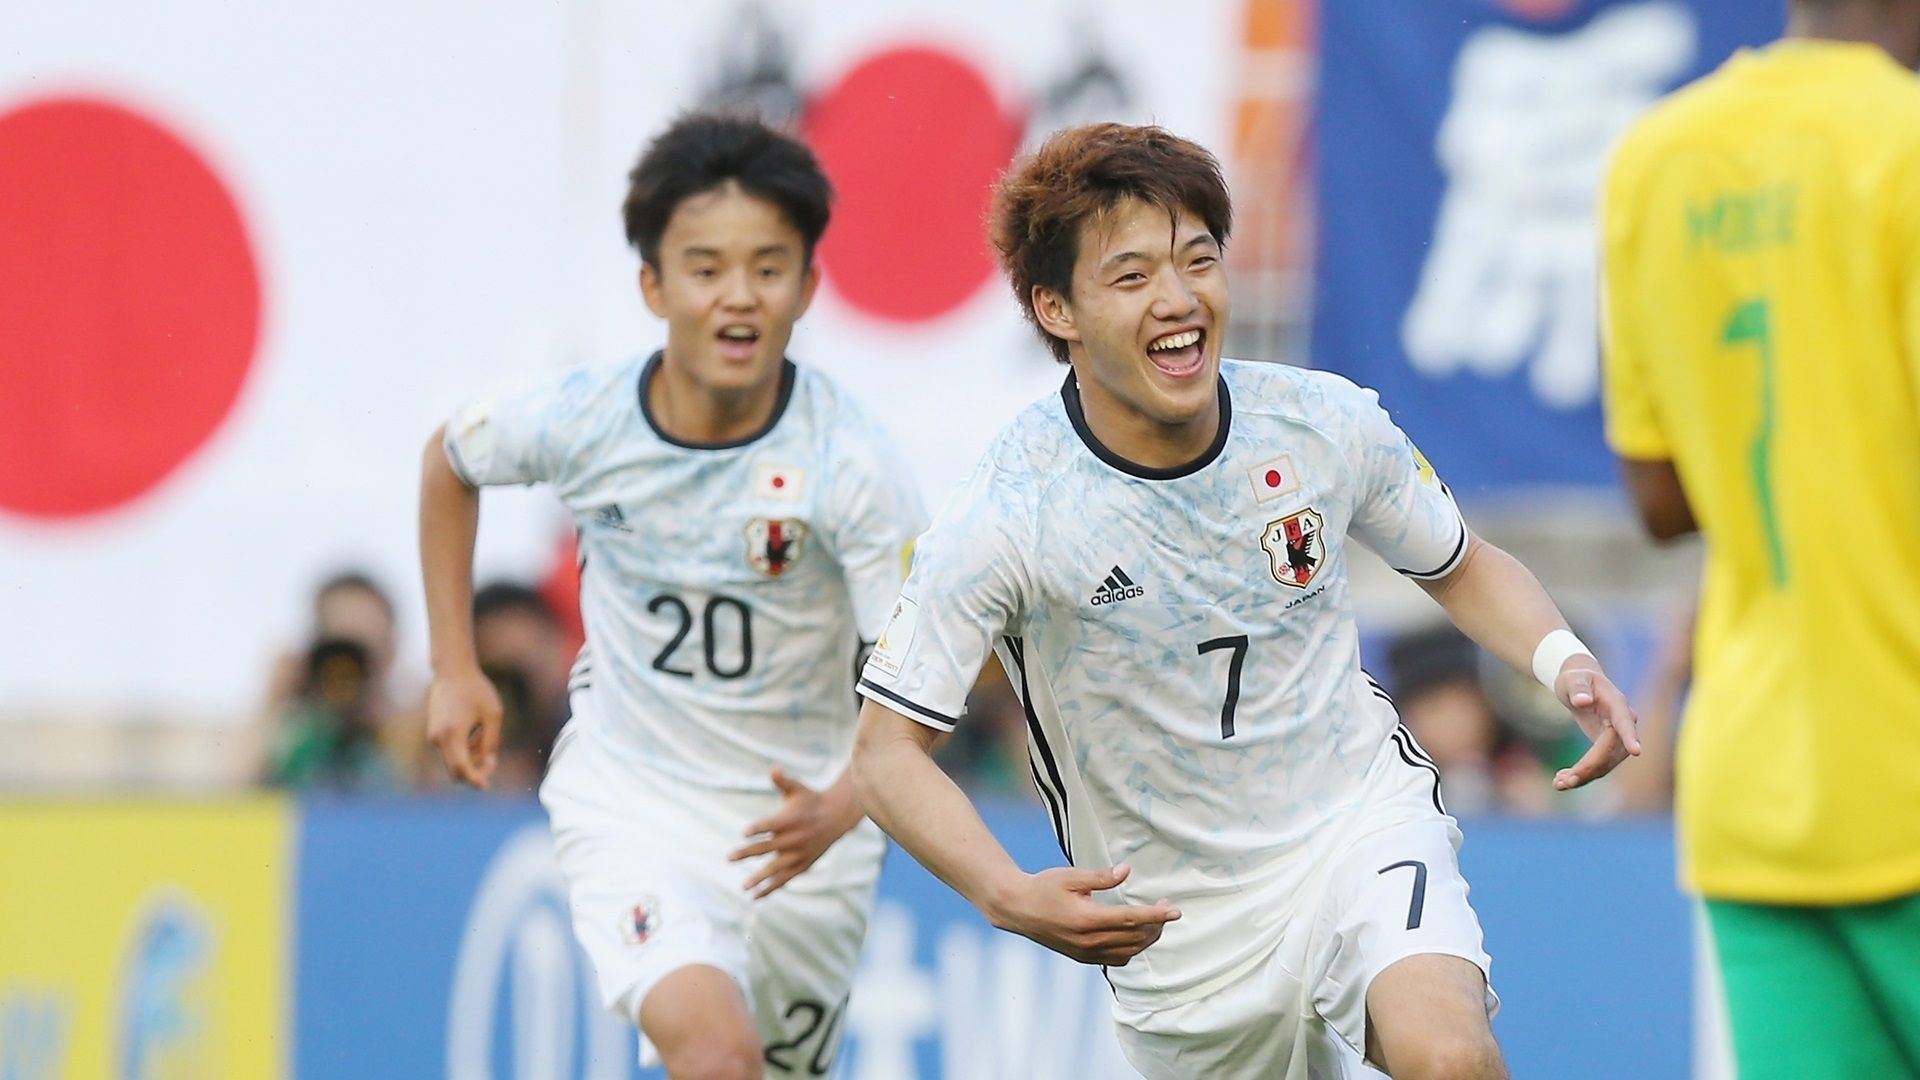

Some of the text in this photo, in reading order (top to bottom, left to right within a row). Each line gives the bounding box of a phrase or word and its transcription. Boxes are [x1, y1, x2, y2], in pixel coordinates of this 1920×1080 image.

[1272, 518, 1314, 542] JFA
[1090, 585, 1144, 606] adidas
[1284, 585, 1325, 609] JAPAN
[647, 594, 753, 680] 20
[1197, 634, 1249, 740] 7
[1377, 859, 1428, 930] 7
